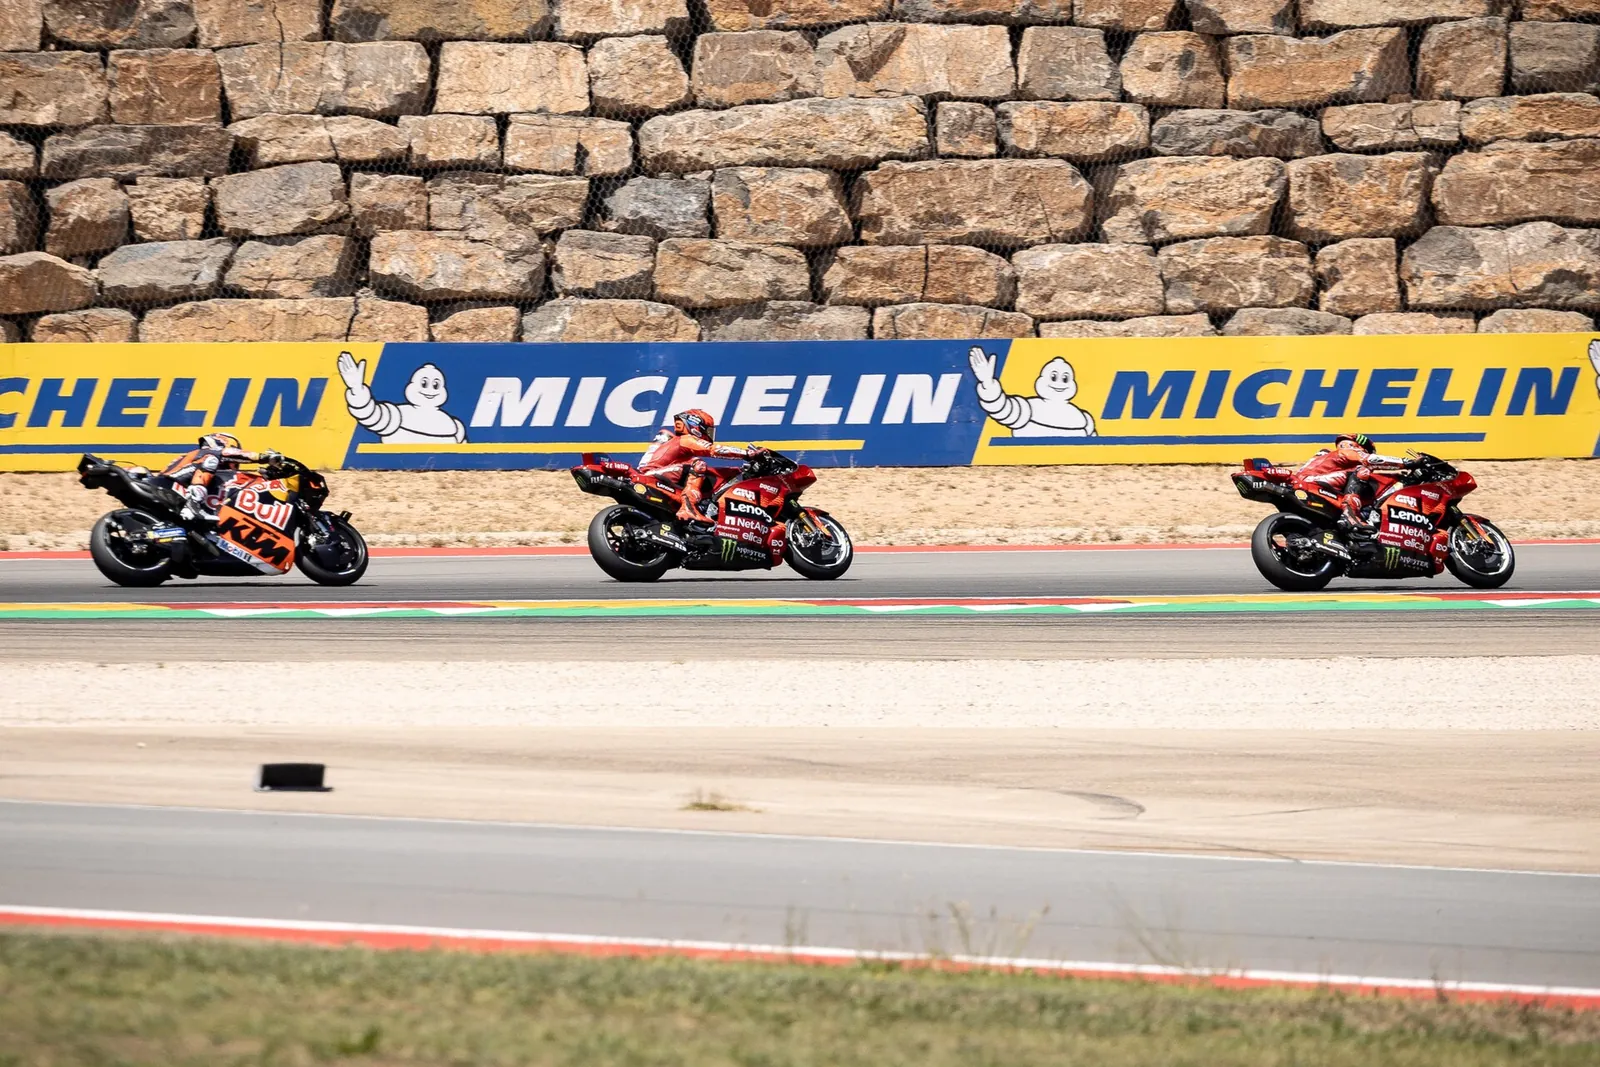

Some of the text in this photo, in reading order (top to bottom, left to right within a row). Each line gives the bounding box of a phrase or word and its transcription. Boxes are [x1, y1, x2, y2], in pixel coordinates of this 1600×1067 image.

[469, 373, 962, 428] MICHELIN
[1100, 367, 1580, 419] MICHELIN
[235, 488, 293, 530] Bull
[219, 516, 290, 566] KTM
[742, 532, 762, 544] elica
[1404, 538, 1424, 551] elica
